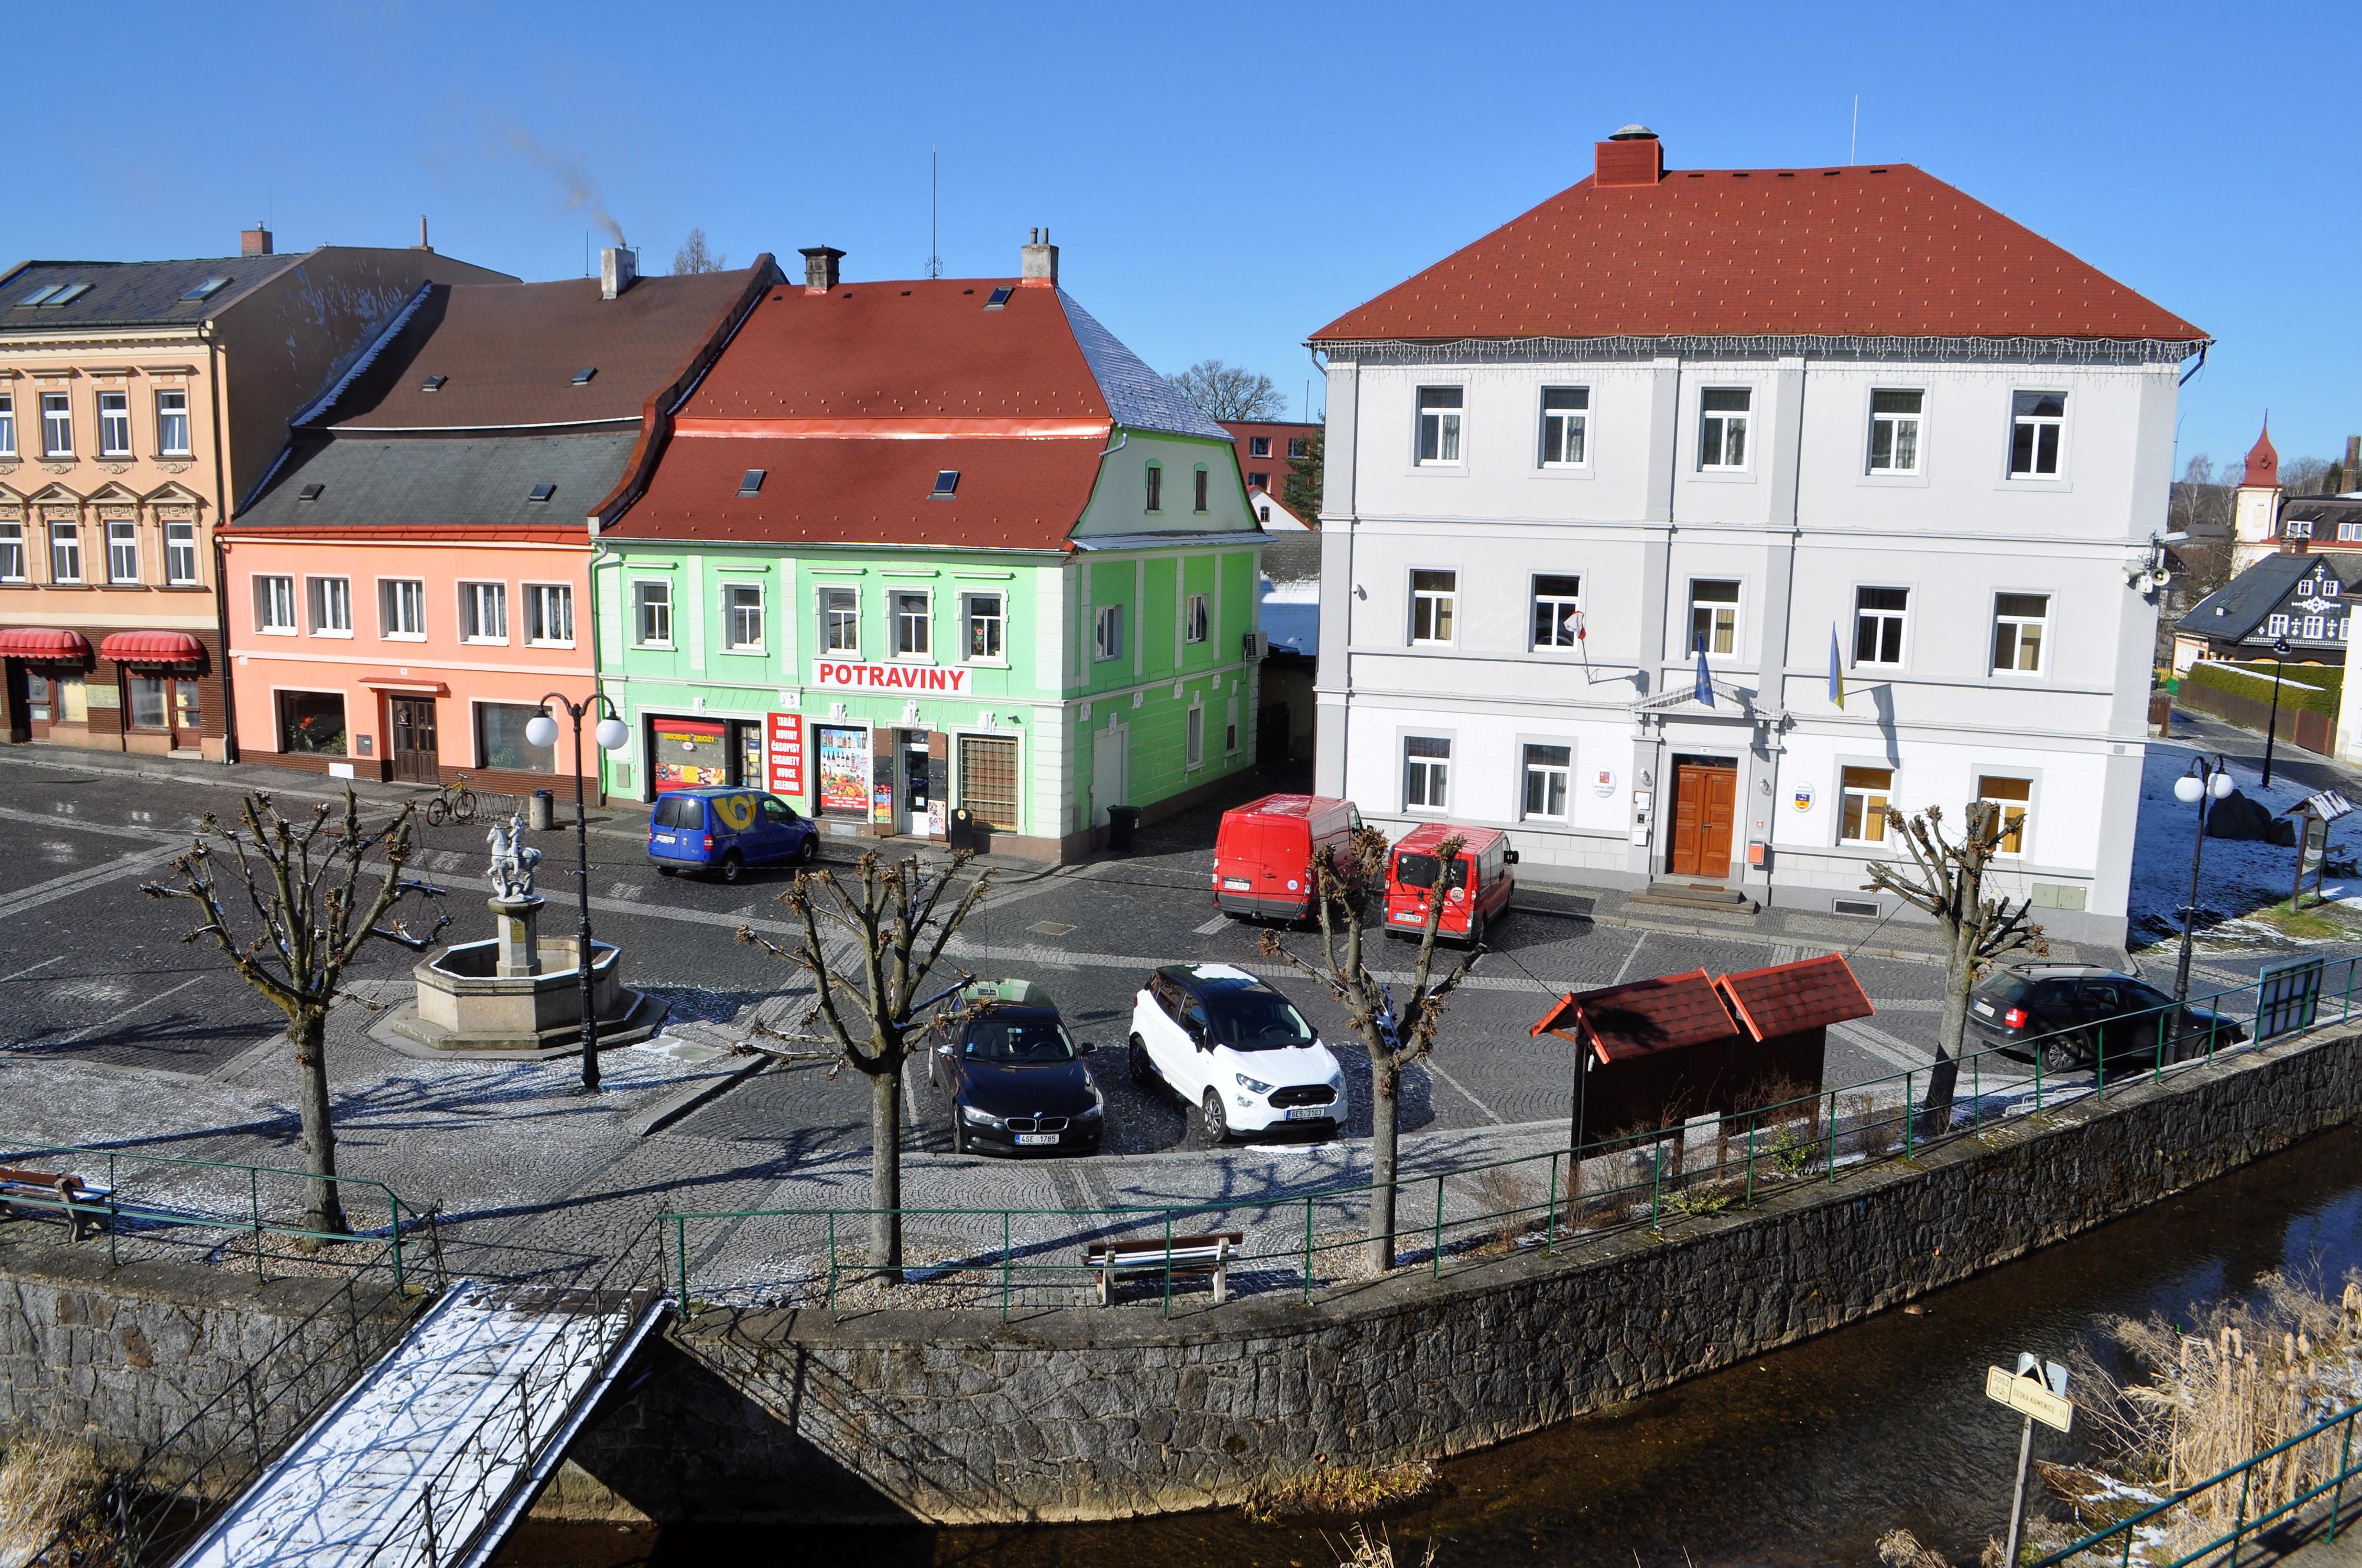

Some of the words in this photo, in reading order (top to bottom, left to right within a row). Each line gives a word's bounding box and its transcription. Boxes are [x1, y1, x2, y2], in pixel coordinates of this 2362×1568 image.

[820, 663, 965, 691] POTRAVINY
[777, 715, 797, 727] TABÁK
[775, 729, 798, 740] NOVINY
[771, 739, 800, 753] ČASOPISY
[772, 754, 800, 766] CIGARETY
[777, 767, 797, 779] OVOCE
[773, 779, 800, 792] ZELENINA
[1993, 1374, 2009, 1387] 3052
[2014, 1389, 2029, 1402] ČESKÁ
[2030, 1398, 2056, 1413] KAMENICE
